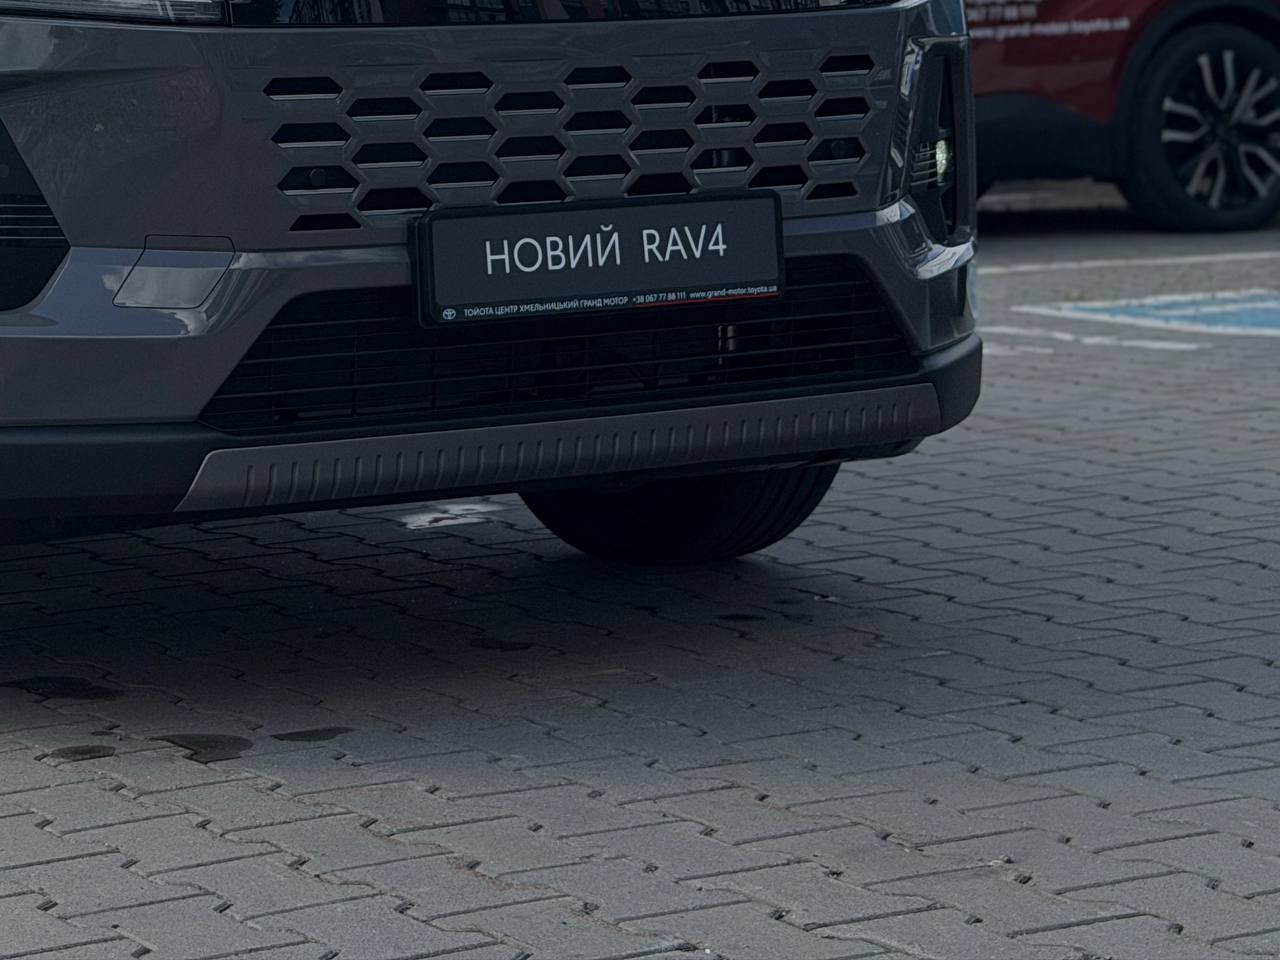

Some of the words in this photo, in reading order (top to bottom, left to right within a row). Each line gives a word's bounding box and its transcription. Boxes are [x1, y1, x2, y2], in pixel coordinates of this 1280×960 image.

[485, 224, 621, 275] НОВИЙ
[642, 224, 727, 263] RAV4
[463, 306, 494, 317] ТОЙОТА
[495, 305, 518, 315] ЦЕНТР
[519, 299, 579, 313] ХМЕЛЬНИЦЬКИЙ
[580, 297, 602, 308] ГРАНД
[603, 295, 628, 306] МОТОР
[645, 293, 658, 303] 067
[658, 293, 667, 302] 77
[676, 291, 687, 300] 111
[689, 285, 778, 299] www.grand-motor.toyota.ua
